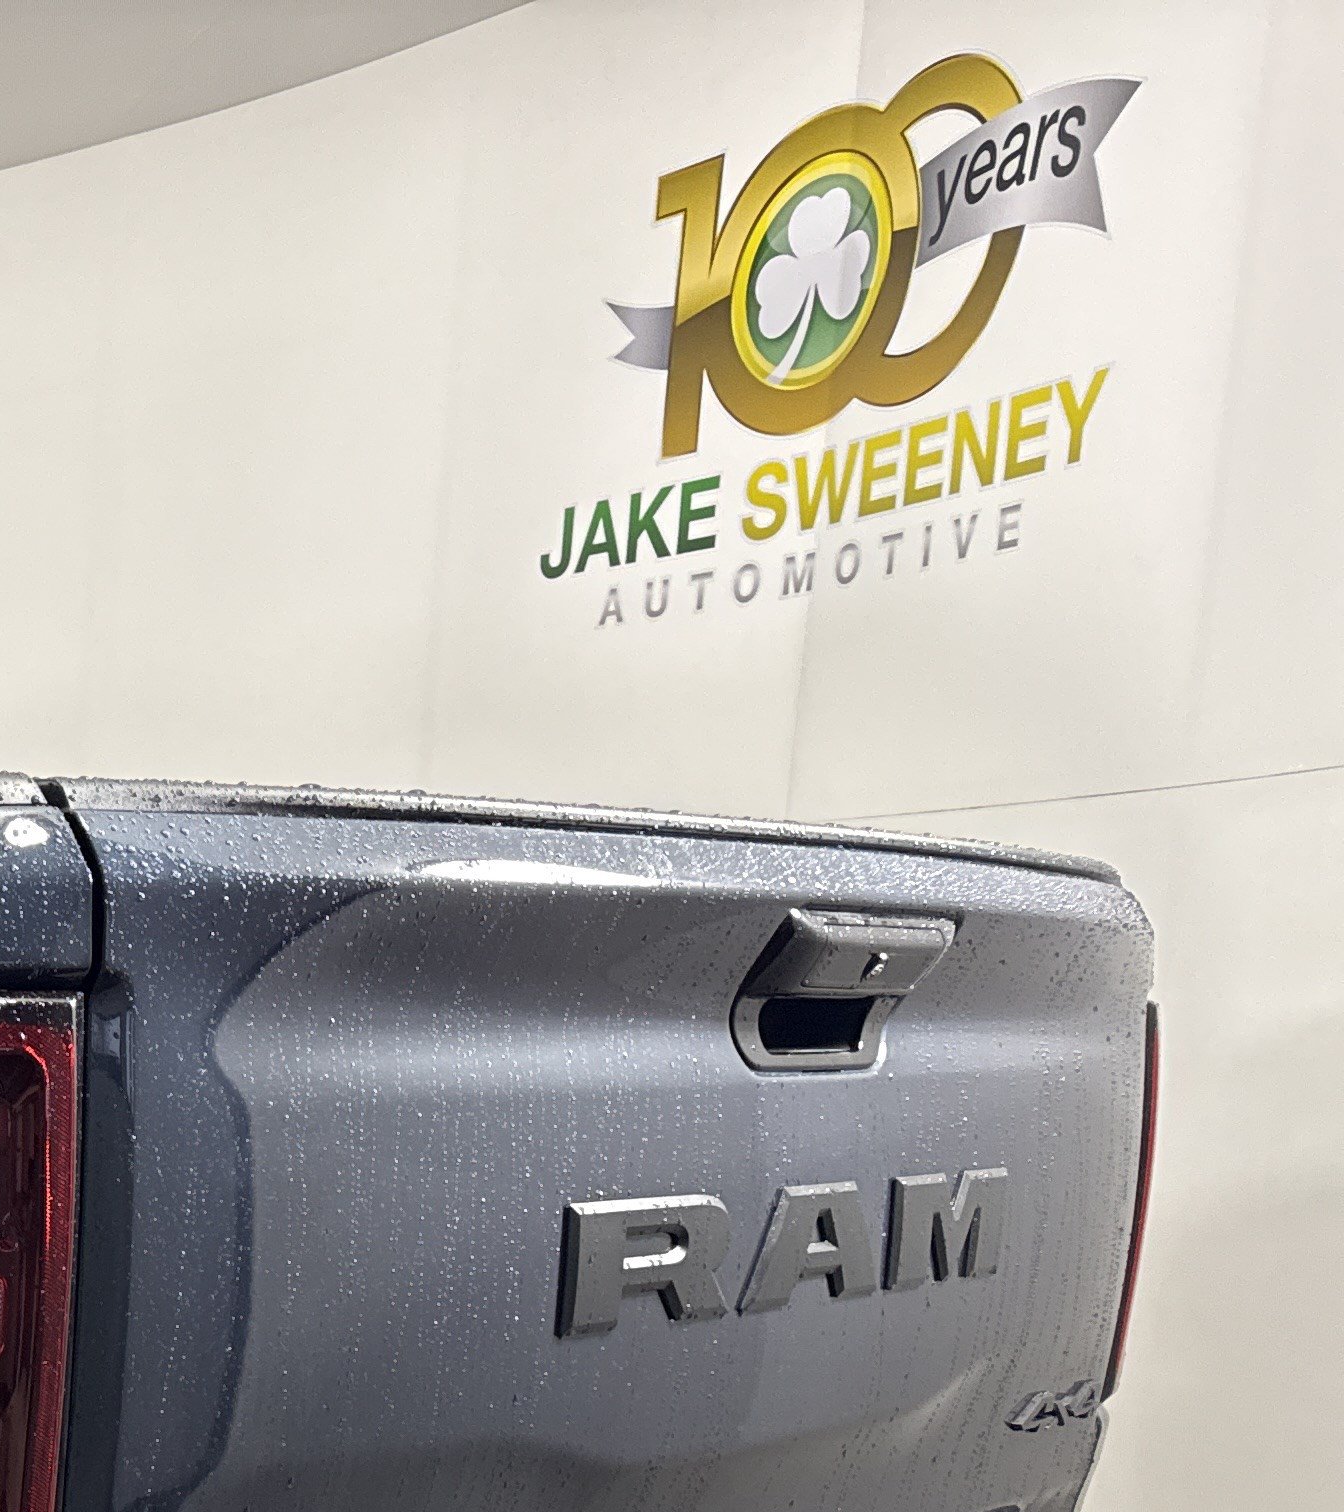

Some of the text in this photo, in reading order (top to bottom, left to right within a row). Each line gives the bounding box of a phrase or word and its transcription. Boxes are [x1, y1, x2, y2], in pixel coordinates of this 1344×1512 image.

[927, 105, 1087, 245] years
[539, 364, 1111, 580] JAKE SWEENEY
[597, 502, 1025, 628] AUTOMOTIVE
[553, 1167, 1010, 1340] RAM
